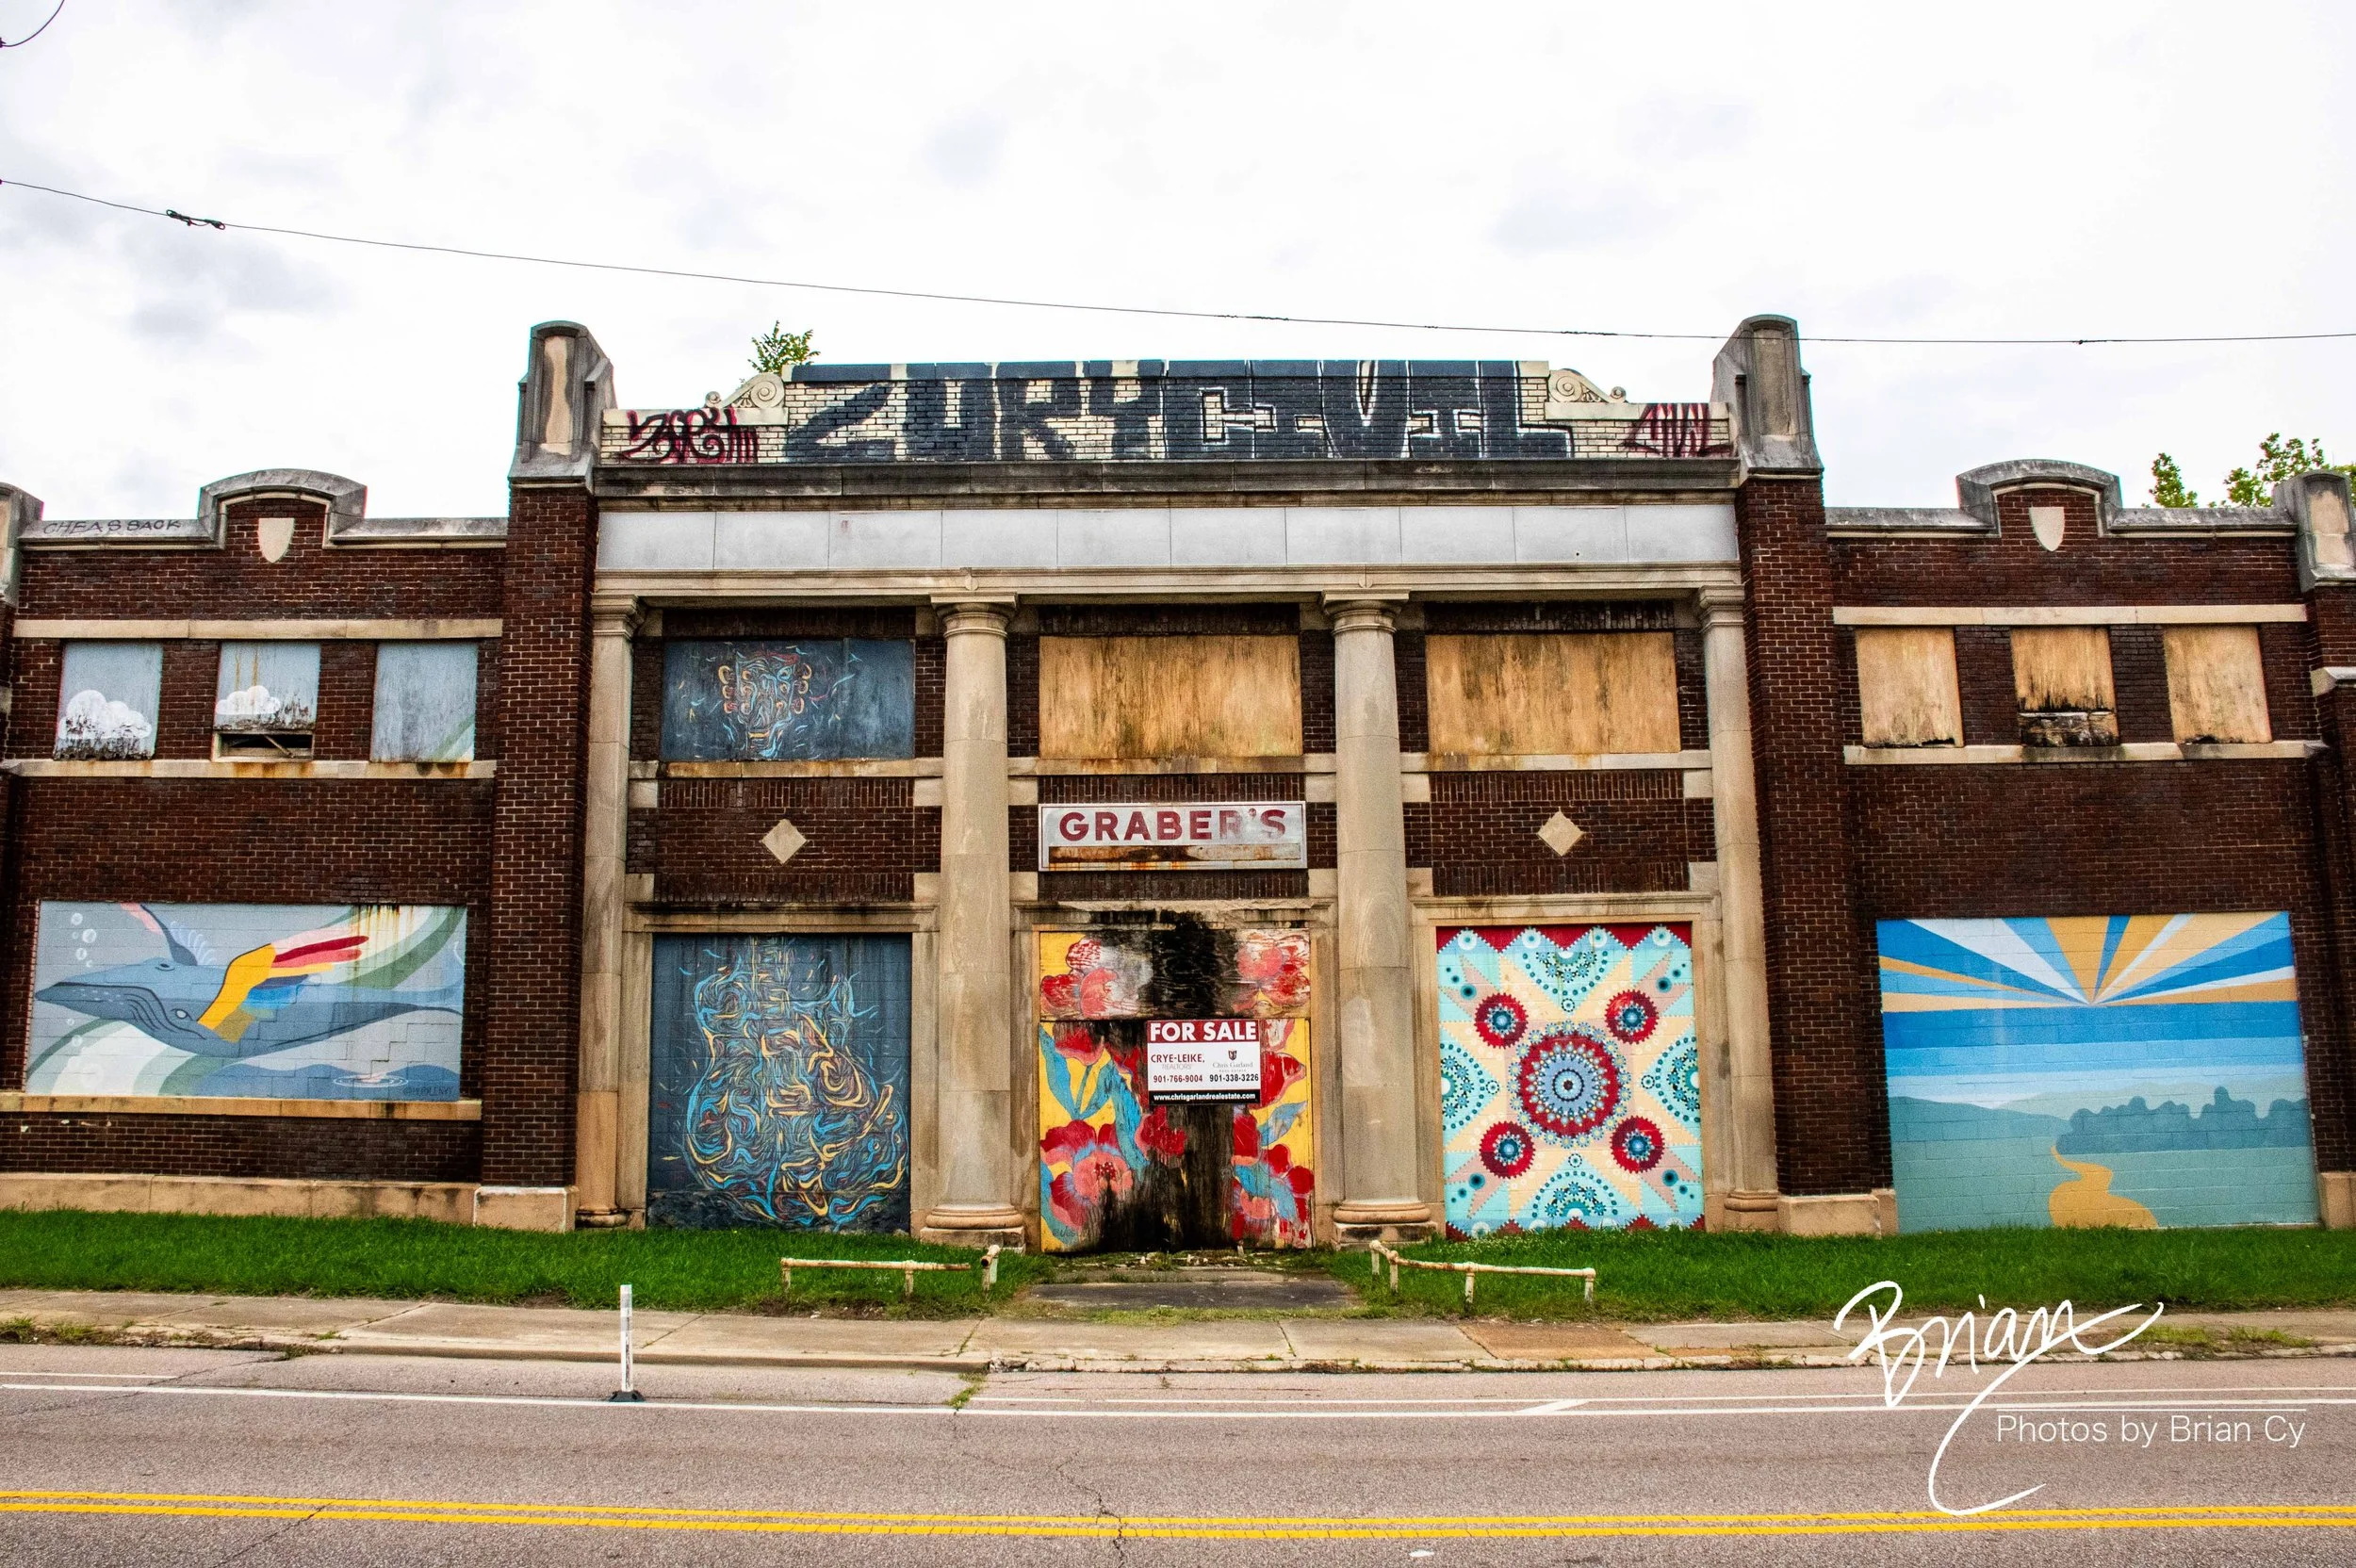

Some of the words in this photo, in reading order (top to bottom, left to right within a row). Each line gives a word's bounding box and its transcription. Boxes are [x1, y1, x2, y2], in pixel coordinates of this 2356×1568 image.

[1058, 808, 1286, 841] GRABER'S
[1150, 1022, 1196, 1042] FOR
[1203, 1021, 1257, 1041] SALE
[1153, 1074, 1203, 1083] 901-766-9004
[1209, 1073, 1259, 1083] 901-338-3226
[1153, 1093, 1256, 1102] www.chrisgarlandrealestate.com
